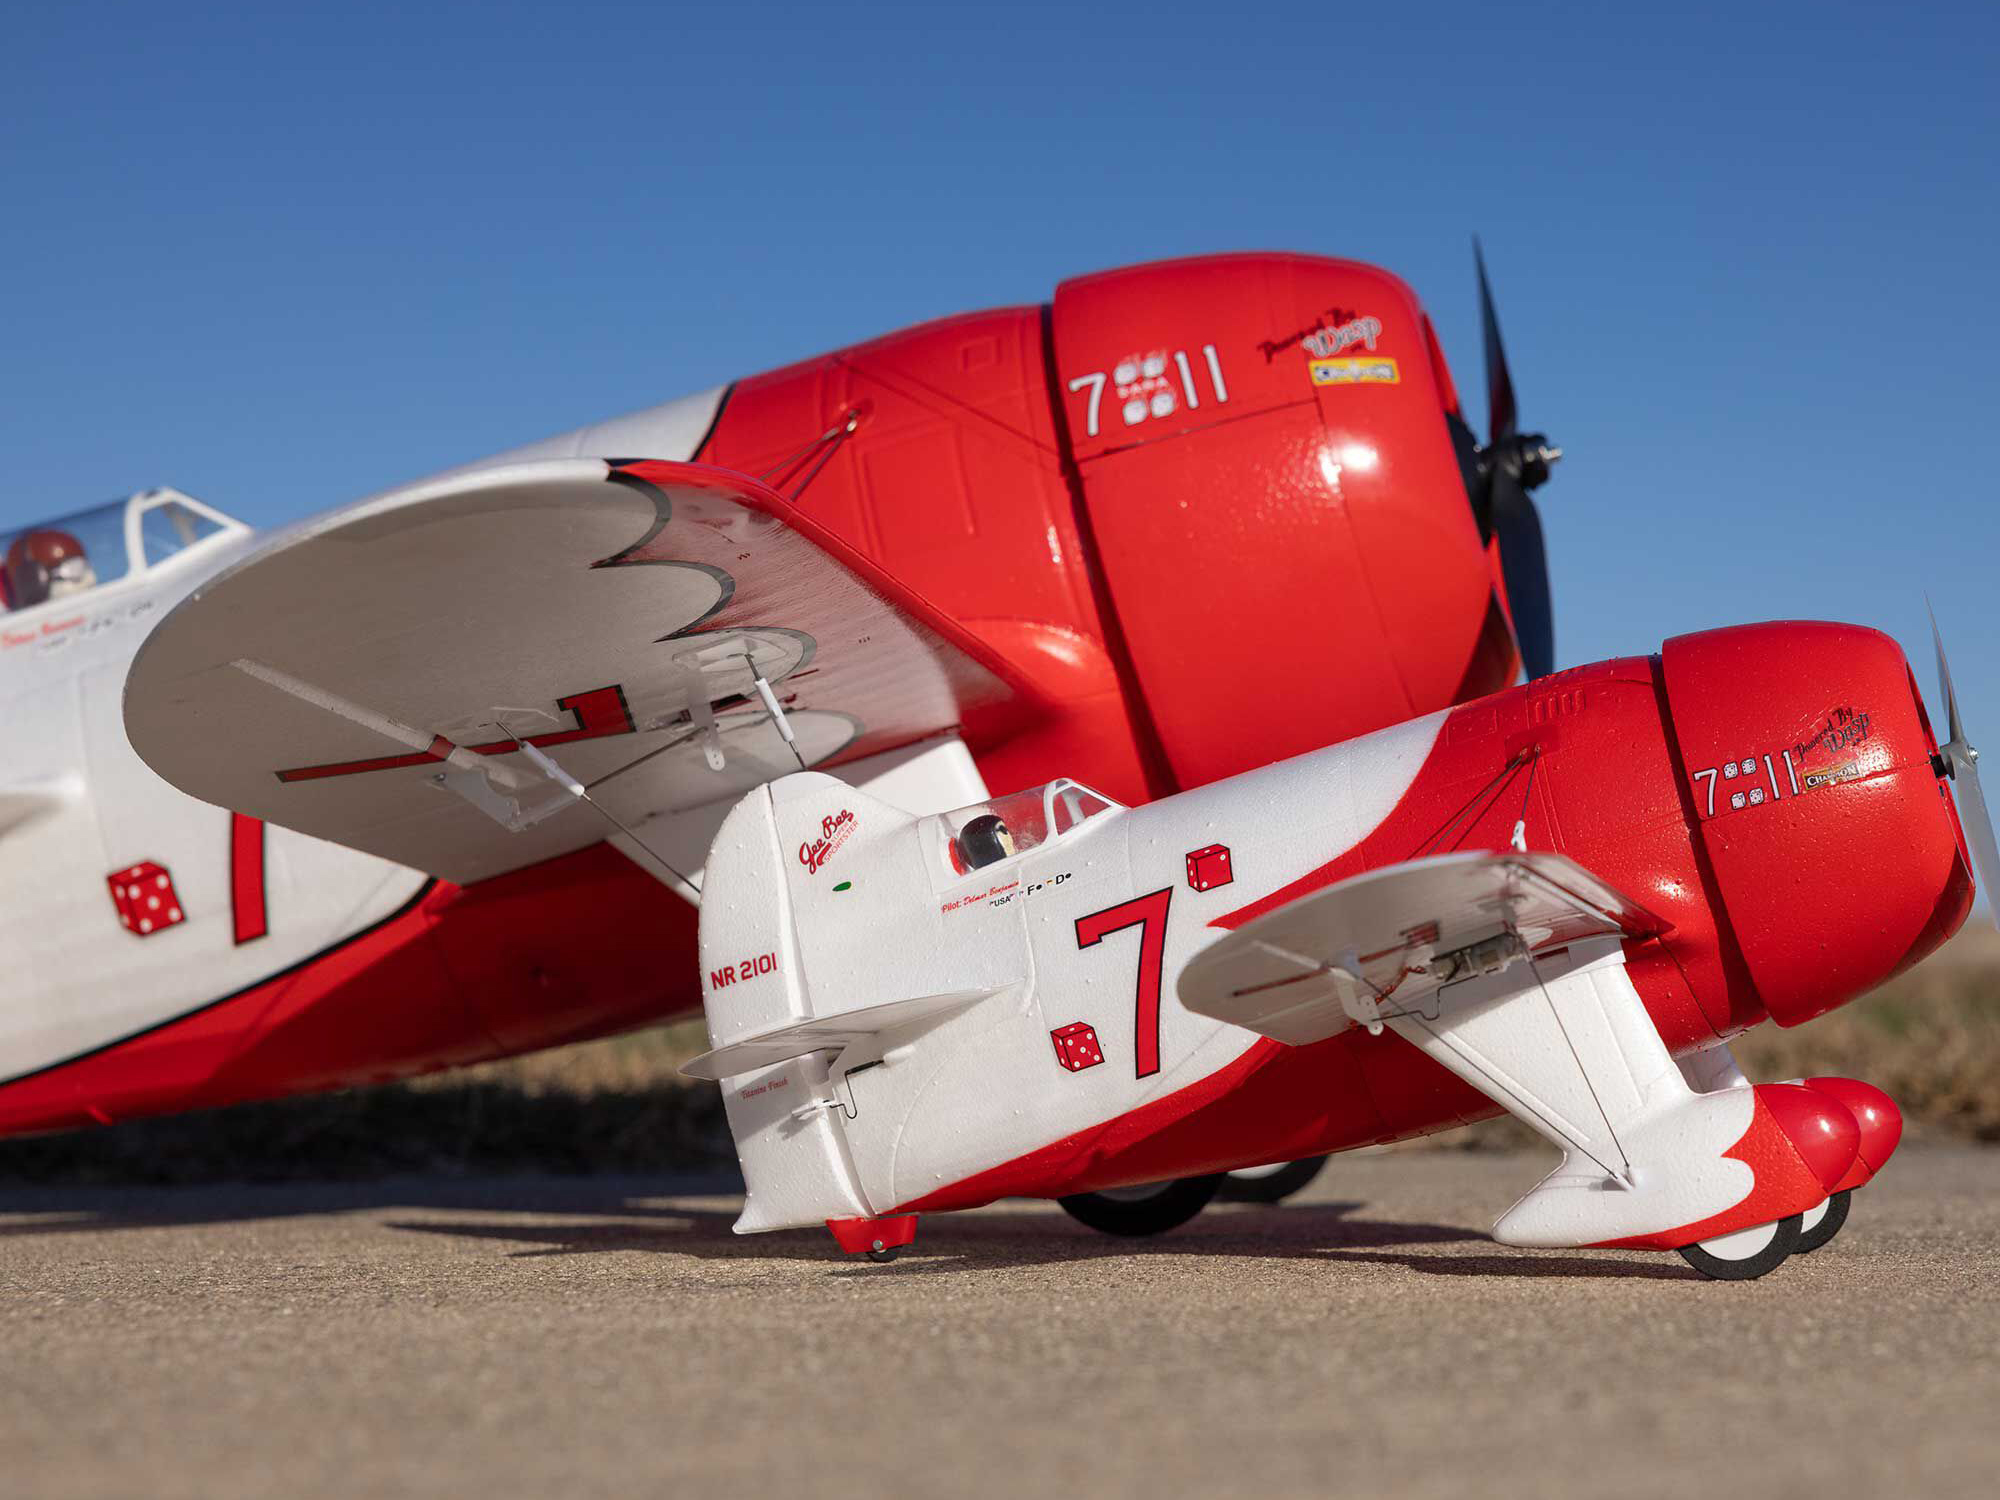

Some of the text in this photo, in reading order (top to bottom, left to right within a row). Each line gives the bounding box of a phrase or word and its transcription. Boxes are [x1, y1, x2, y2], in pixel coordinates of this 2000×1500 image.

[1068, 344, 1229, 438] 7 11
[1822, 712, 1871, 754] Wasp
[1693, 750, 1800, 817] 7 11
[799, 808, 854, 875] Gee Bee
[710, 952, 778, 991] NR 2101
[1074, 885, 1175, 1080] 7
